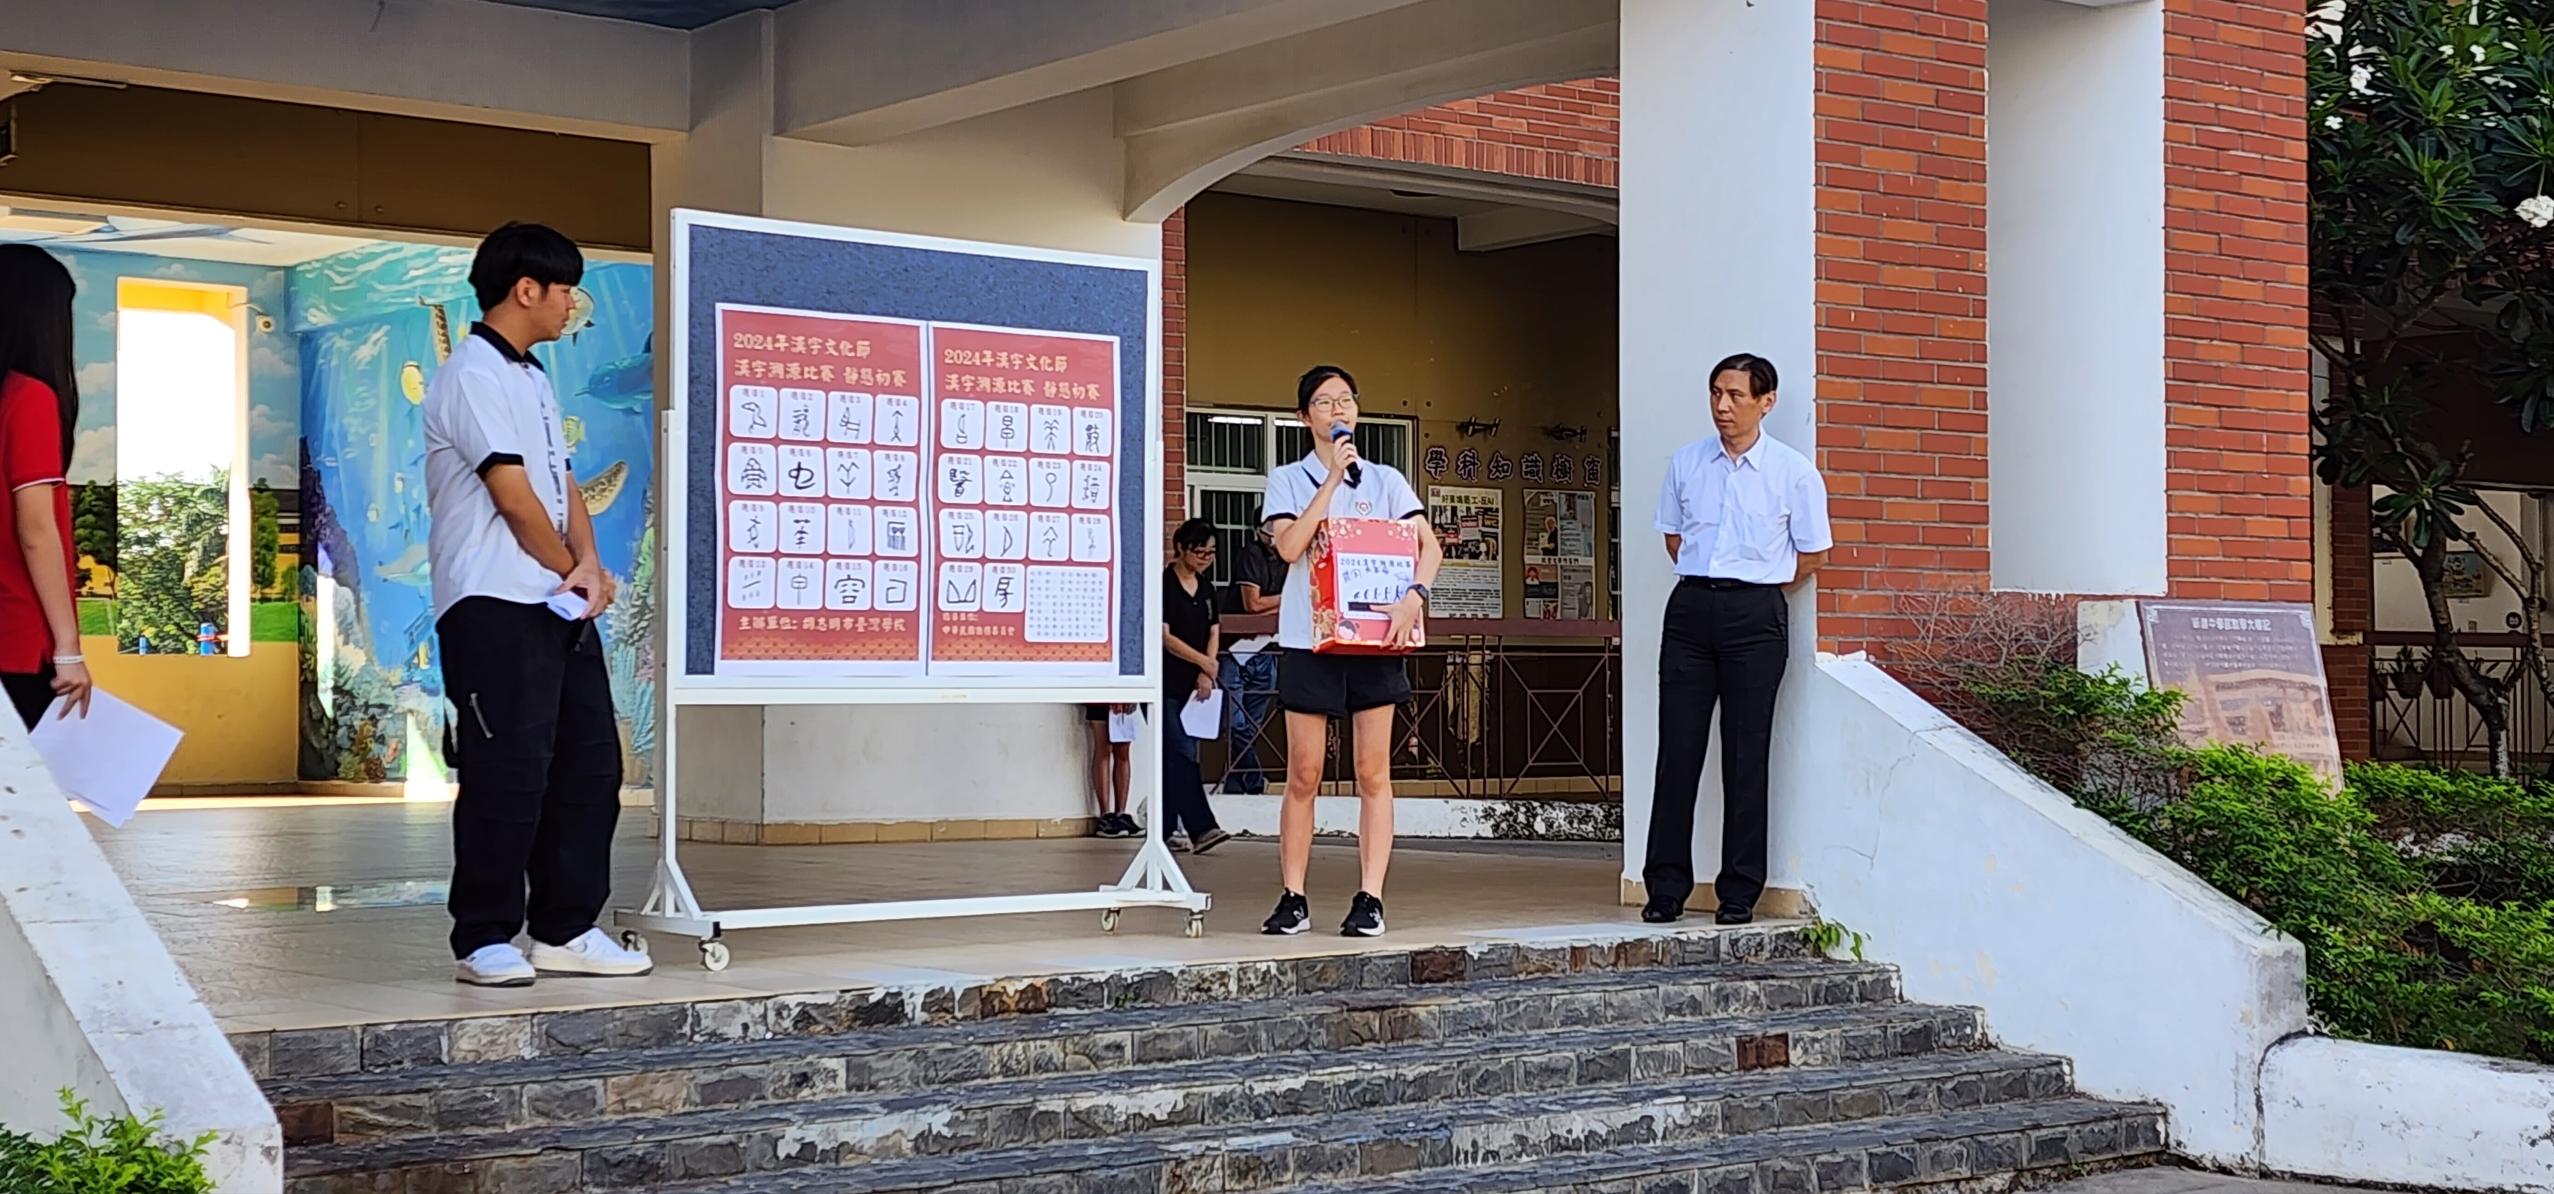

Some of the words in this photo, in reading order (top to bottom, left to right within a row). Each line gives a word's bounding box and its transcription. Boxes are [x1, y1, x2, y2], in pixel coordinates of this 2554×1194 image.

[733, 332, 871, 359] 2024年漢字文化節
[735, 359, 835, 383] 漢字溯源比賽
[944, 349, 1068, 373] 2024年漢字文化節
[945, 373, 1035, 396] 漢字溯源比賽
[1425, 447, 1602, 486] 學科知識櫥窗
